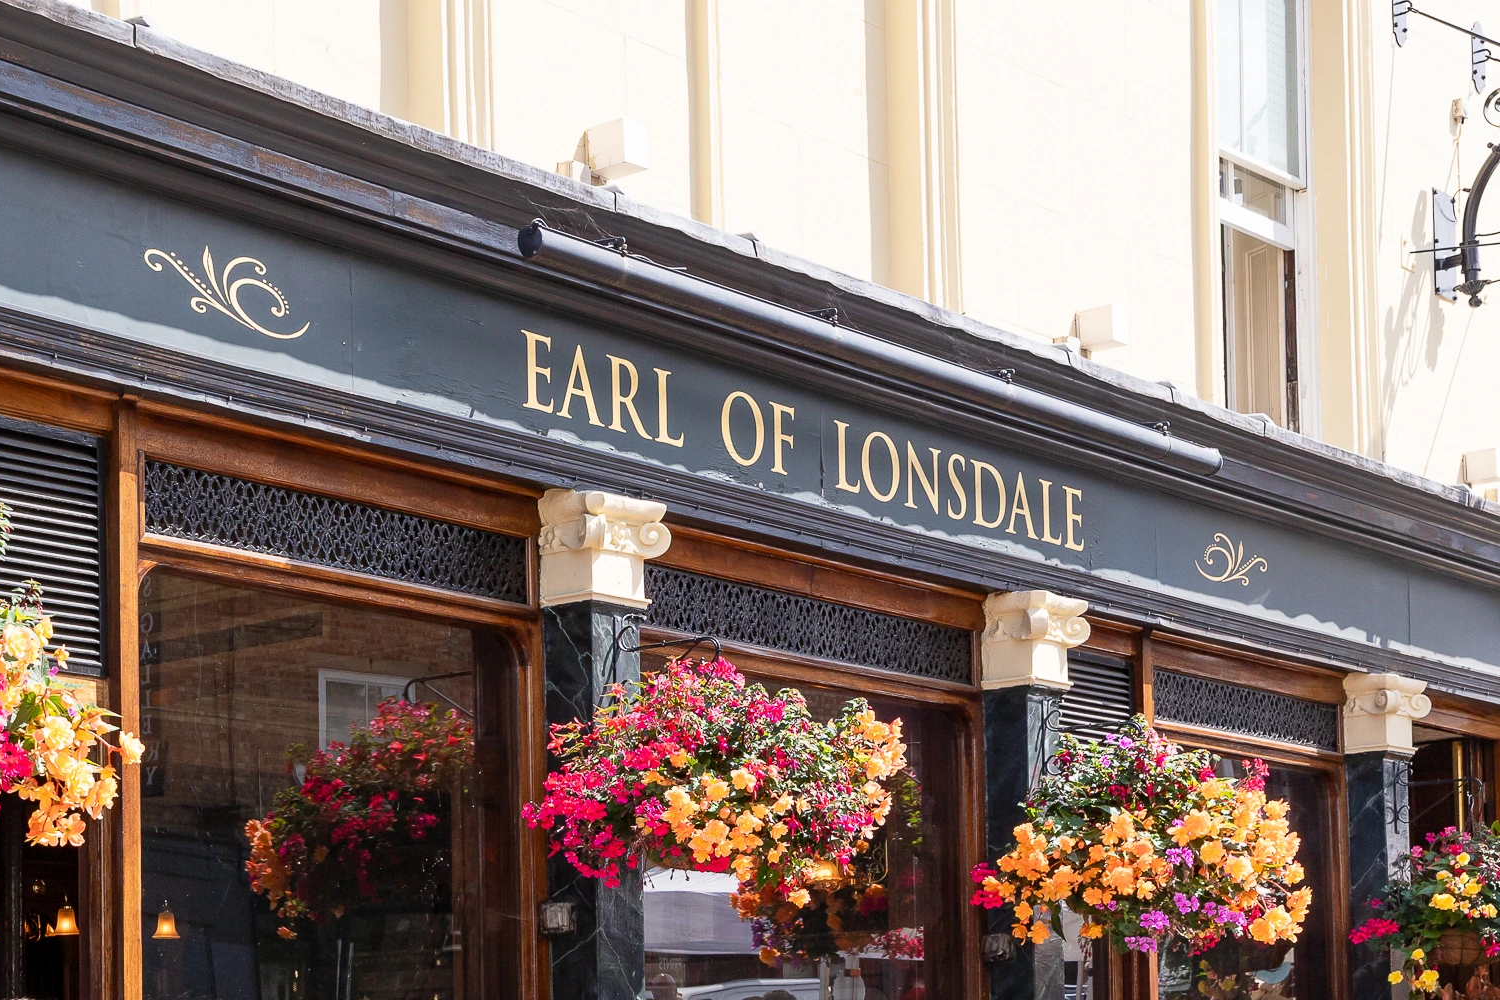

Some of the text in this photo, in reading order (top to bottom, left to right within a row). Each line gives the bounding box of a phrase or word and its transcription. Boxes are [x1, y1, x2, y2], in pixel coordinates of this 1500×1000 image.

[521, 328, 1085, 552] EARL OF LONSDALE
